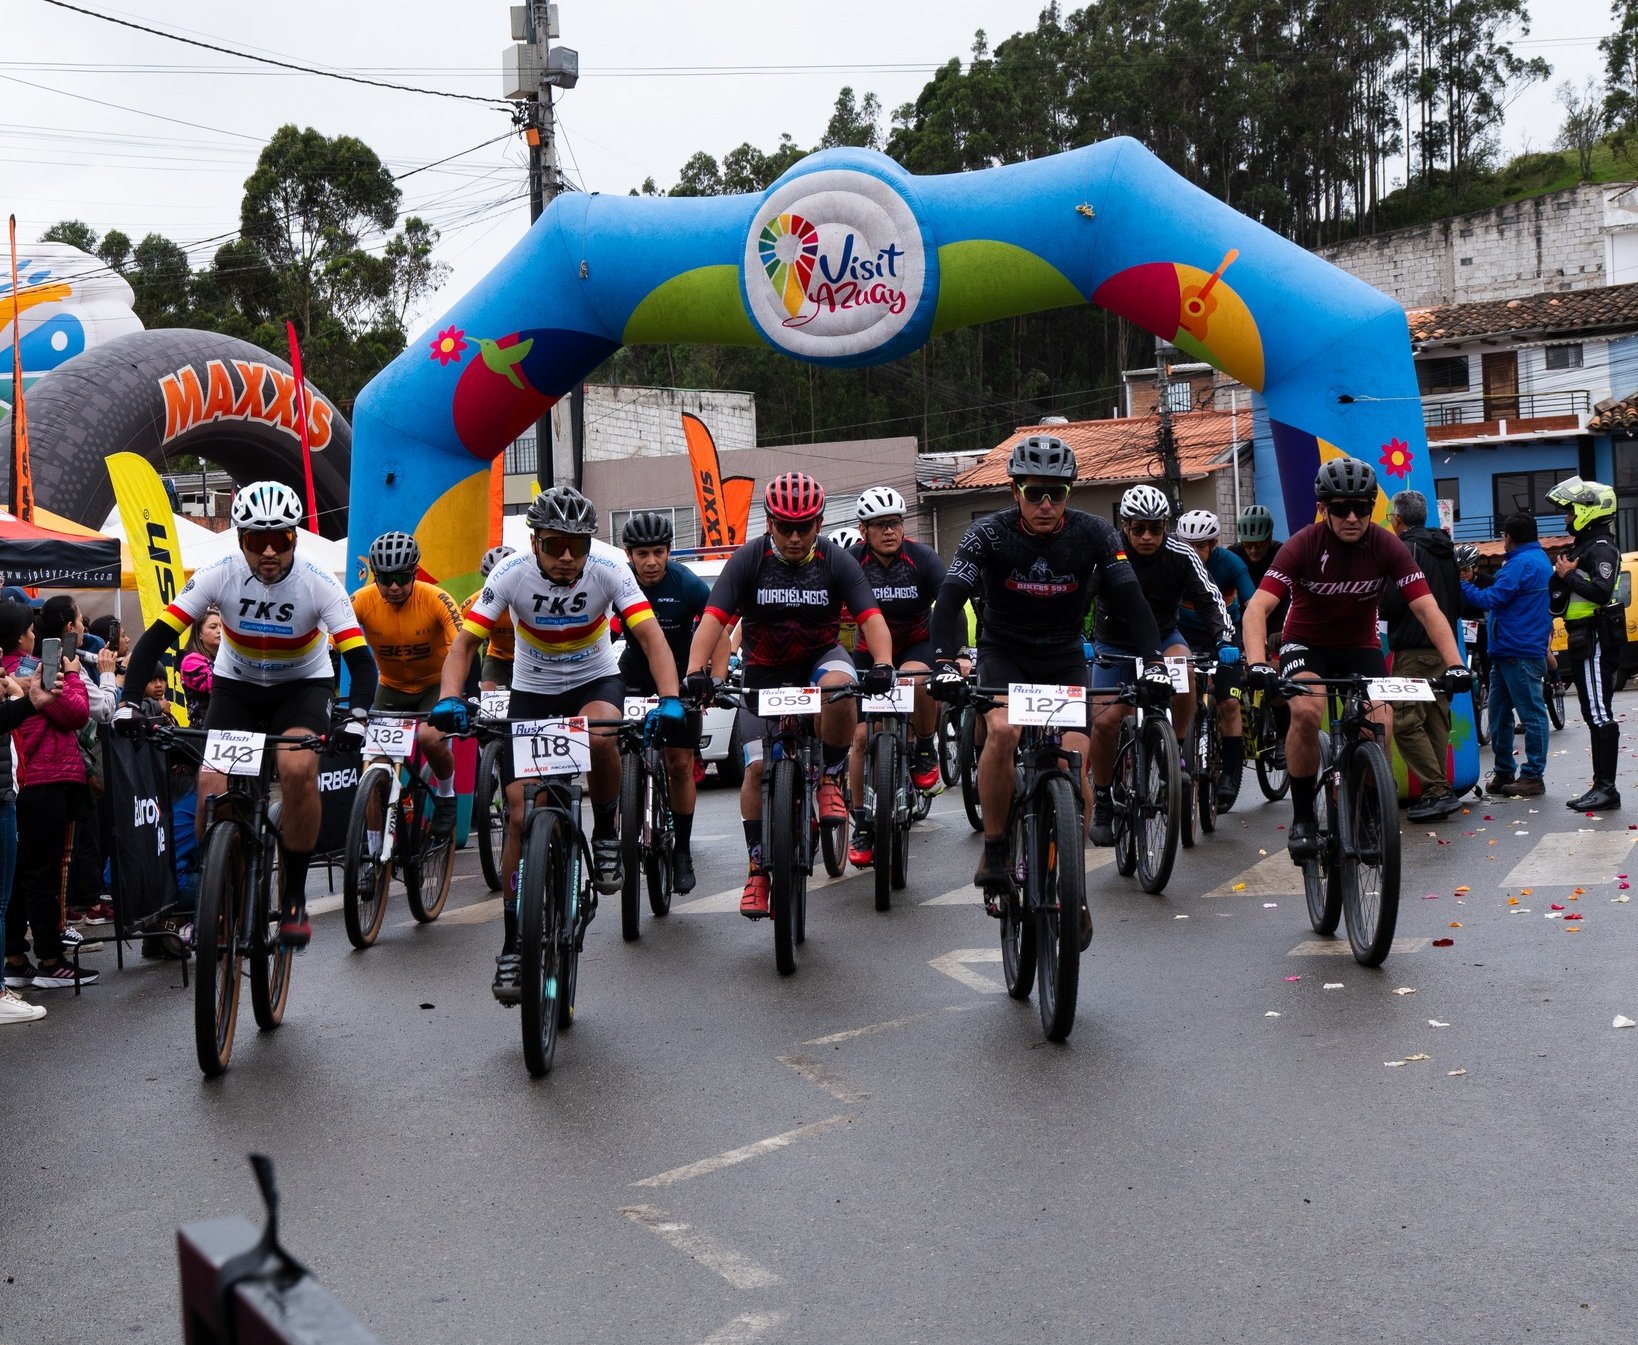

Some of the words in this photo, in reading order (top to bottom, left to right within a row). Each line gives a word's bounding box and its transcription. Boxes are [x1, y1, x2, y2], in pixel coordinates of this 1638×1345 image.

[819, 233, 905, 284] Visit
[158, 359, 333, 451] MAXXIS
[1051, 584, 1067, 592] 593
[239, 598, 295, 622] TKS
[532, 591, 588, 616] TKS
[936, 673, 964, 683] FOX
[1146, 673, 1172, 685] FOX
[1013, 685, 1042, 695] Rush
[1377, 684, 1419, 694] 136
[767, 695, 811, 707] 059
[1025, 697, 1069, 714] 127
[371, 728, 405, 745] 132
[515, 723, 545, 736] Rush
[221, 732, 250, 743] Rush
[210, 743, 254, 764] 143
[530, 735, 571, 759] 118
